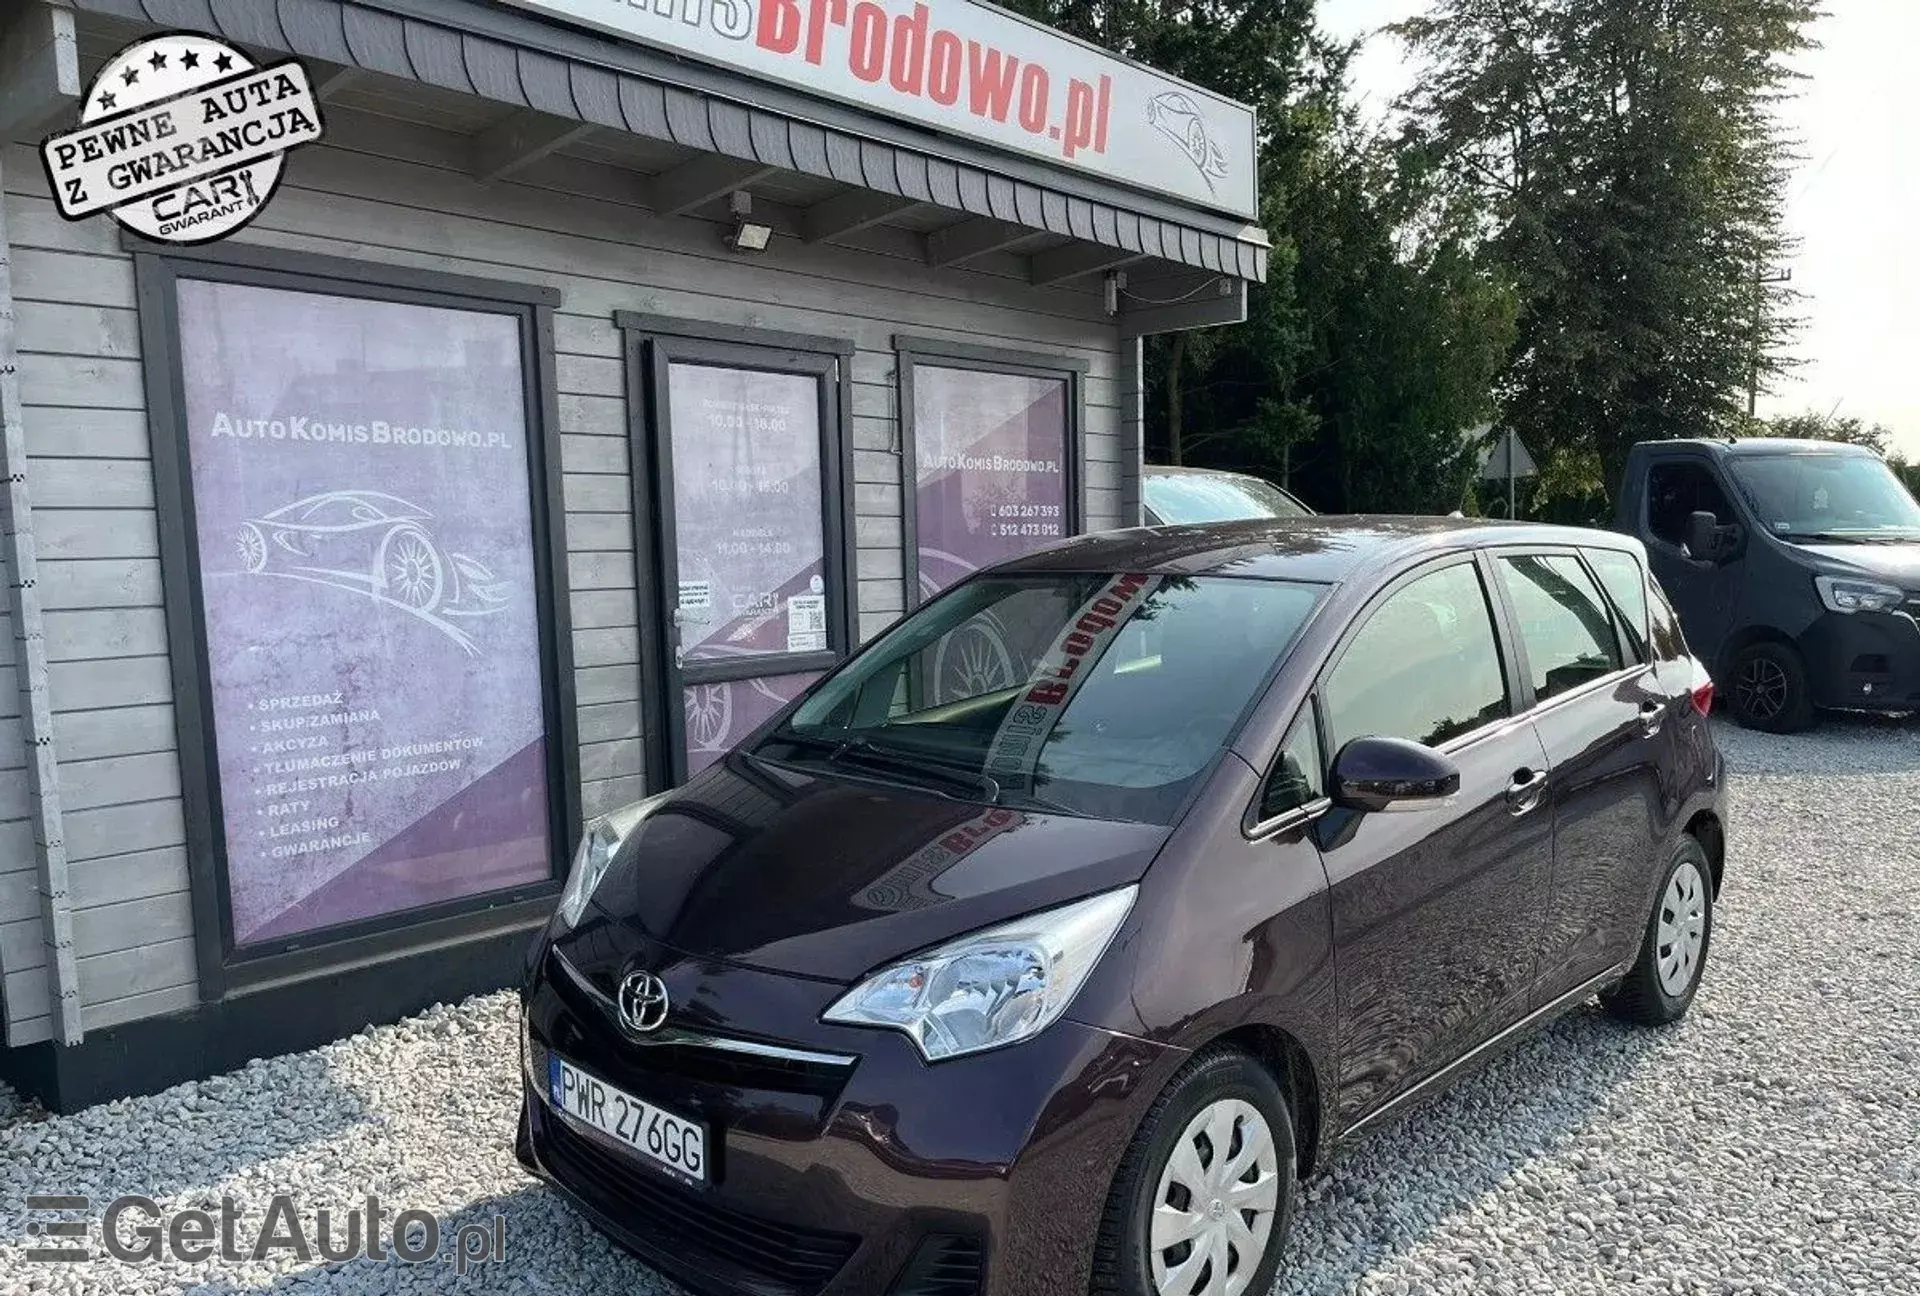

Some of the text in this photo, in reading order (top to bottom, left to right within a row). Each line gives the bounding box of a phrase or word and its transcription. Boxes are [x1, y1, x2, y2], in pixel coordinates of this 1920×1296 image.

[998, 505, 1060, 517] 603 267 393
[1000, 525, 1059, 536] 512 473 012
[259, 691, 343, 711] SPRZEDAŻ
[262, 735, 329, 754] AKCYZA
[264, 749, 377, 774] TŁUMACZENIE
[267, 772, 378, 795] REJESTRACJA
[268, 800, 310, 817] RATY
[270, 816, 340, 838] LEASING
[272, 832, 372, 859] GWARANCJE
[562, 1065, 701, 1172] PWR 276GG
